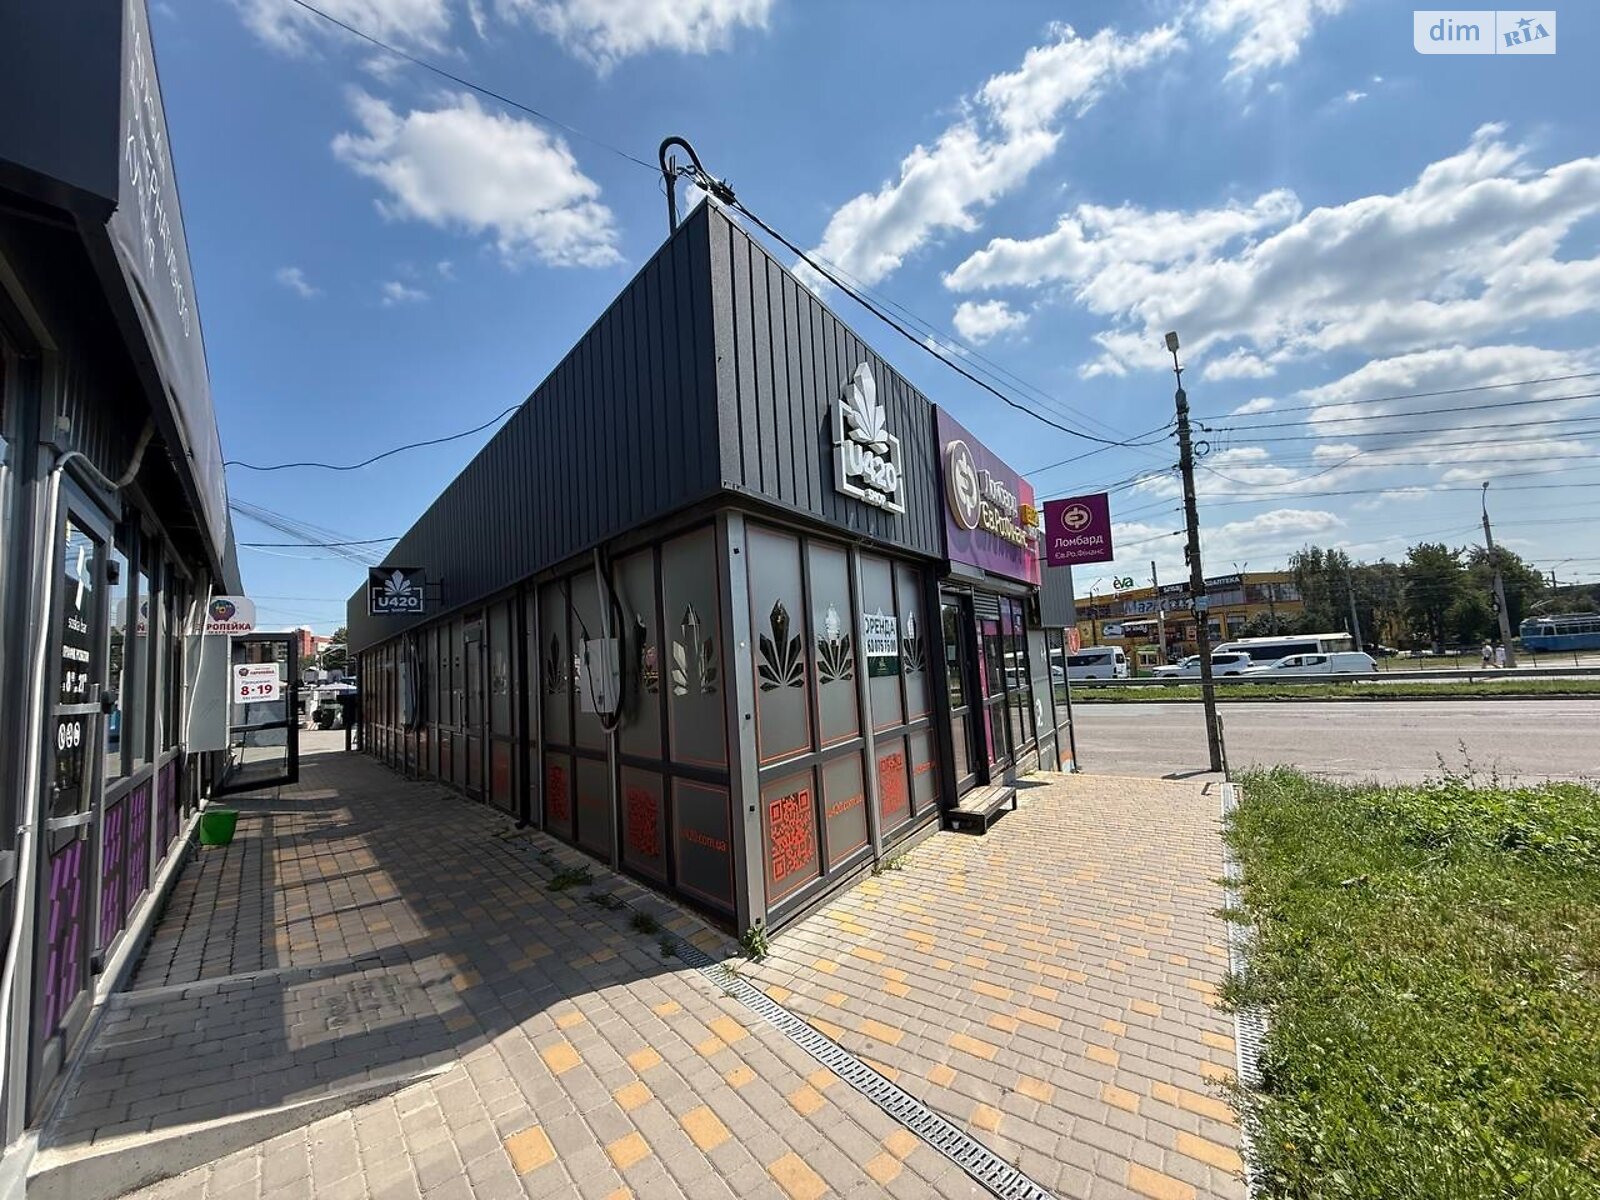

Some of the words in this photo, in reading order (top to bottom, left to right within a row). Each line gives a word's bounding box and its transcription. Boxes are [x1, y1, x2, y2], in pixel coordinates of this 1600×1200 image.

[840, 439, 897, 493] U420
[1054, 534, 1104, 548] Ломбард
[378, 596, 418, 607] U420
[240, 686, 250, 696] 8
[257, 684, 273, 695] 19
